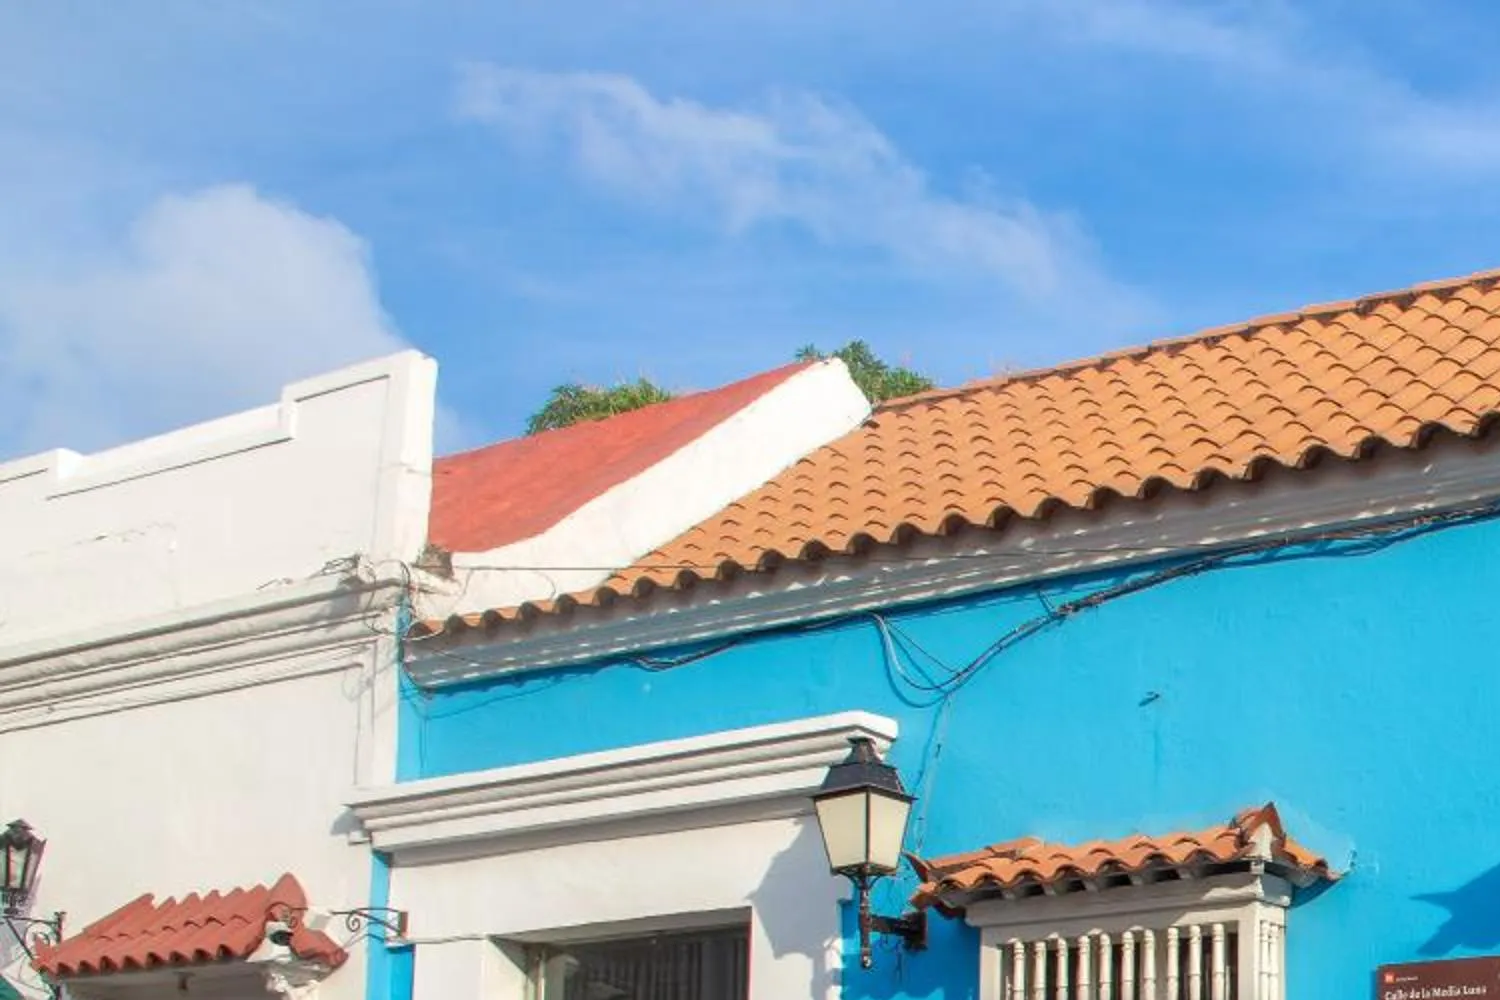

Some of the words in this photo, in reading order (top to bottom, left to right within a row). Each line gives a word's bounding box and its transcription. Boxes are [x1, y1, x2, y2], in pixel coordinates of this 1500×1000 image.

[1409, 988, 1420, 999] de
[1421, 987, 1431, 999] la
[1431, 985, 1461, 997] Media
[1463, 984, 1487, 996] Luna
